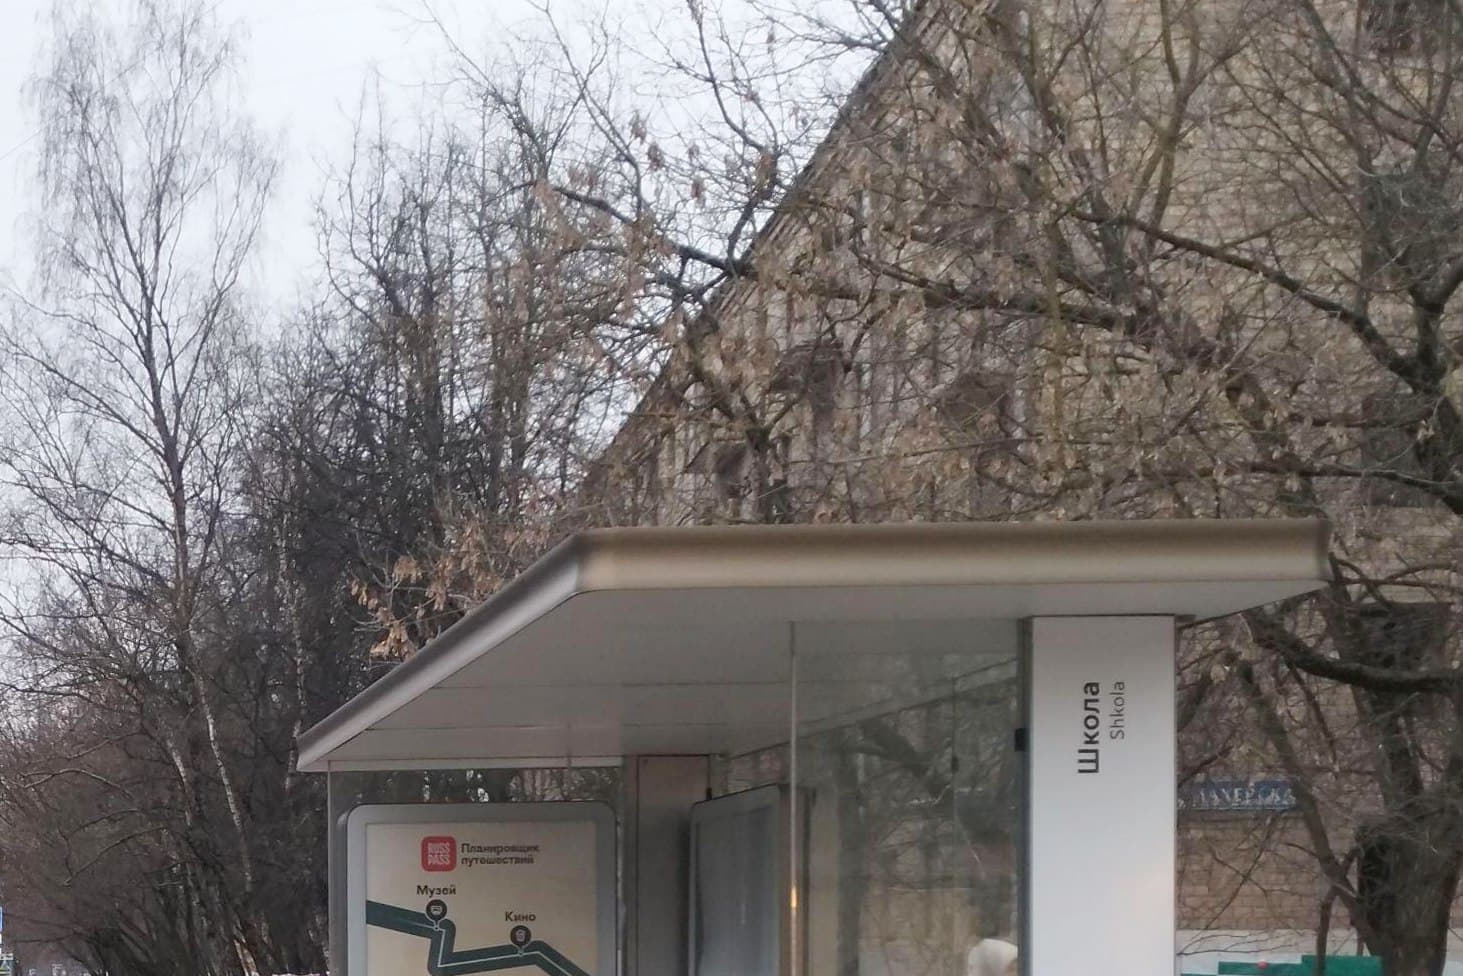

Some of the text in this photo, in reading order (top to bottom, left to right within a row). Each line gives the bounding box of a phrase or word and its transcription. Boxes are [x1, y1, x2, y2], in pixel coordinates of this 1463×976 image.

[1109, 681, 1125, 740] Shkola
[1077, 681, 1100, 773] Школа
[461, 843, 539, 855] Планировщик
[461, 855, 535, 867] путешествий
[416, 884, 457, 898] Музей
[504, 911, 537, 923] Кино
